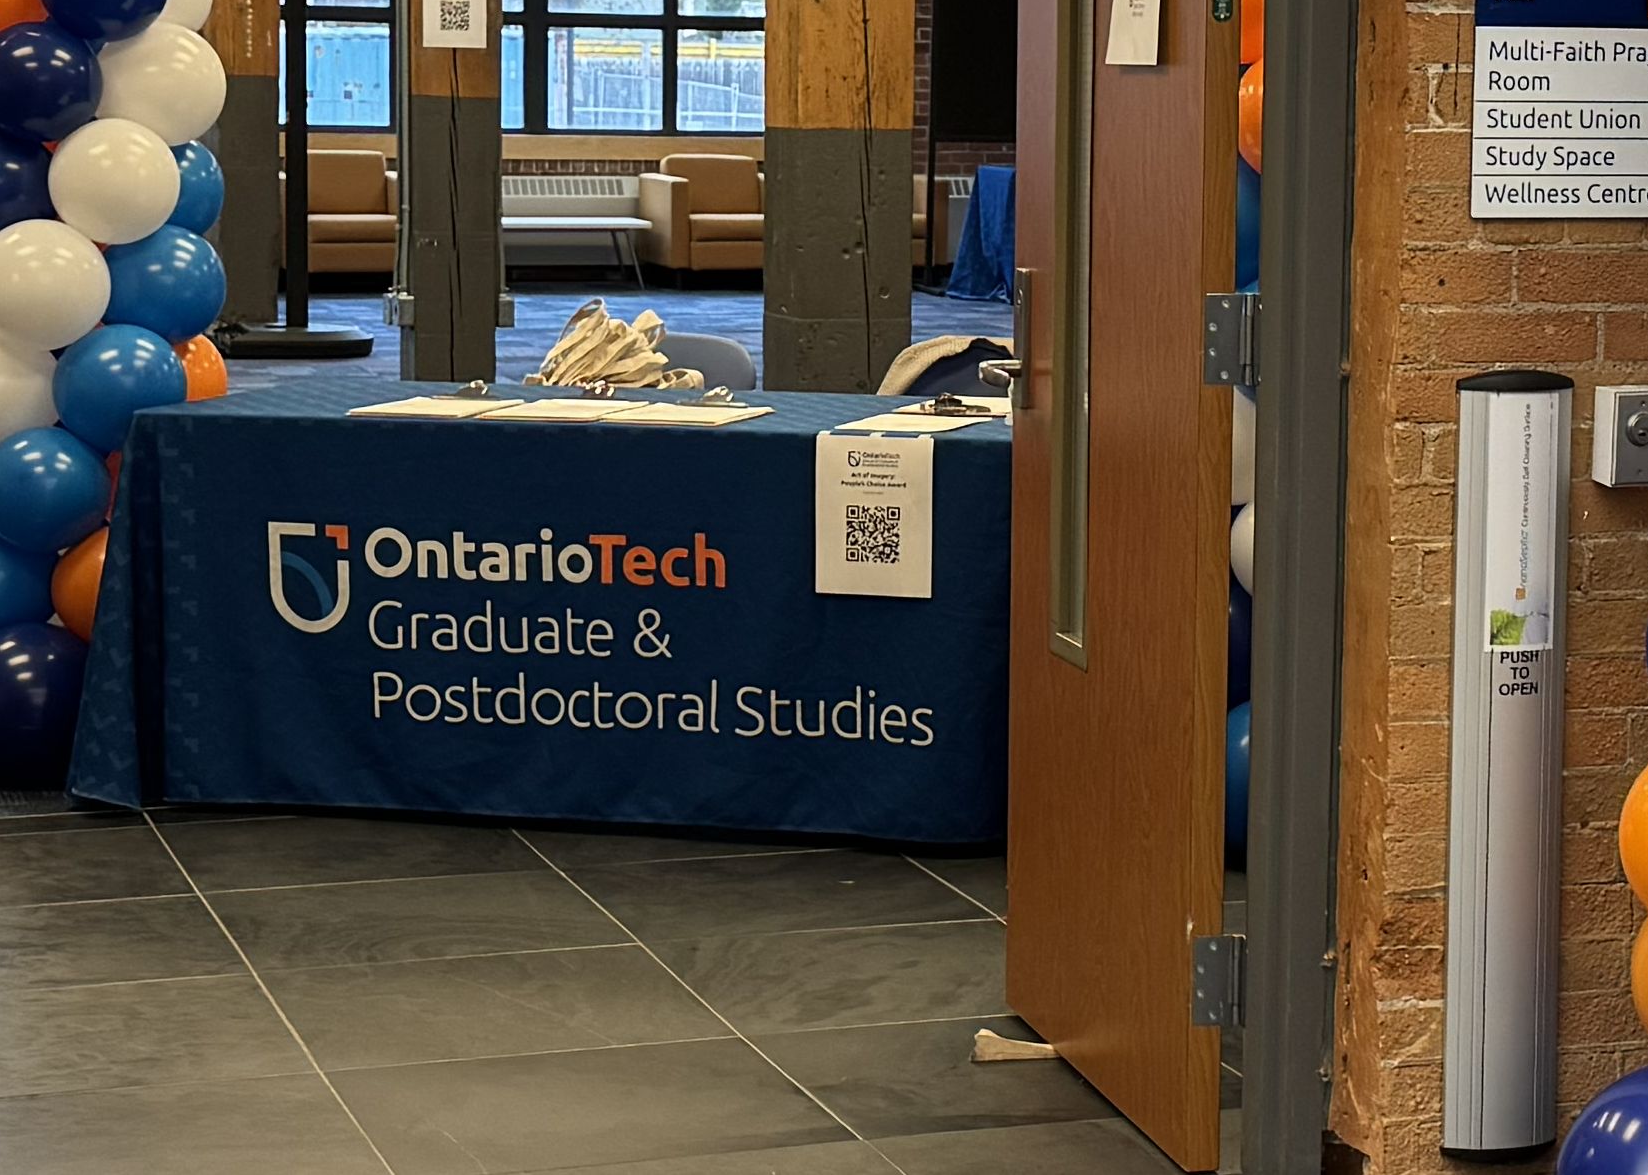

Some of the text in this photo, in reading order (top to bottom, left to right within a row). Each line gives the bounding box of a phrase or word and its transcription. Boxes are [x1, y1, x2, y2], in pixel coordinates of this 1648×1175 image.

[1488, 39, 1607, 63] Multi-Faith
[1488, 71, 1551, 92] Room
[1486, 108, 1642, 130] Student Union
[1485, 145, 1616, 171] Study Space
[1484, 182, 1581, 204] Wellness
[363, 528, 728, 589] OntarioTech
[368, 599, 673, 659] Graduate &
[1499, 649, 1541, 664] PUSH
[1509, 666, 1530, 680] TO
[1498, 682, 1539, 696] OPEN
[371, 670, 935, 748] Postdoctoral Studies
